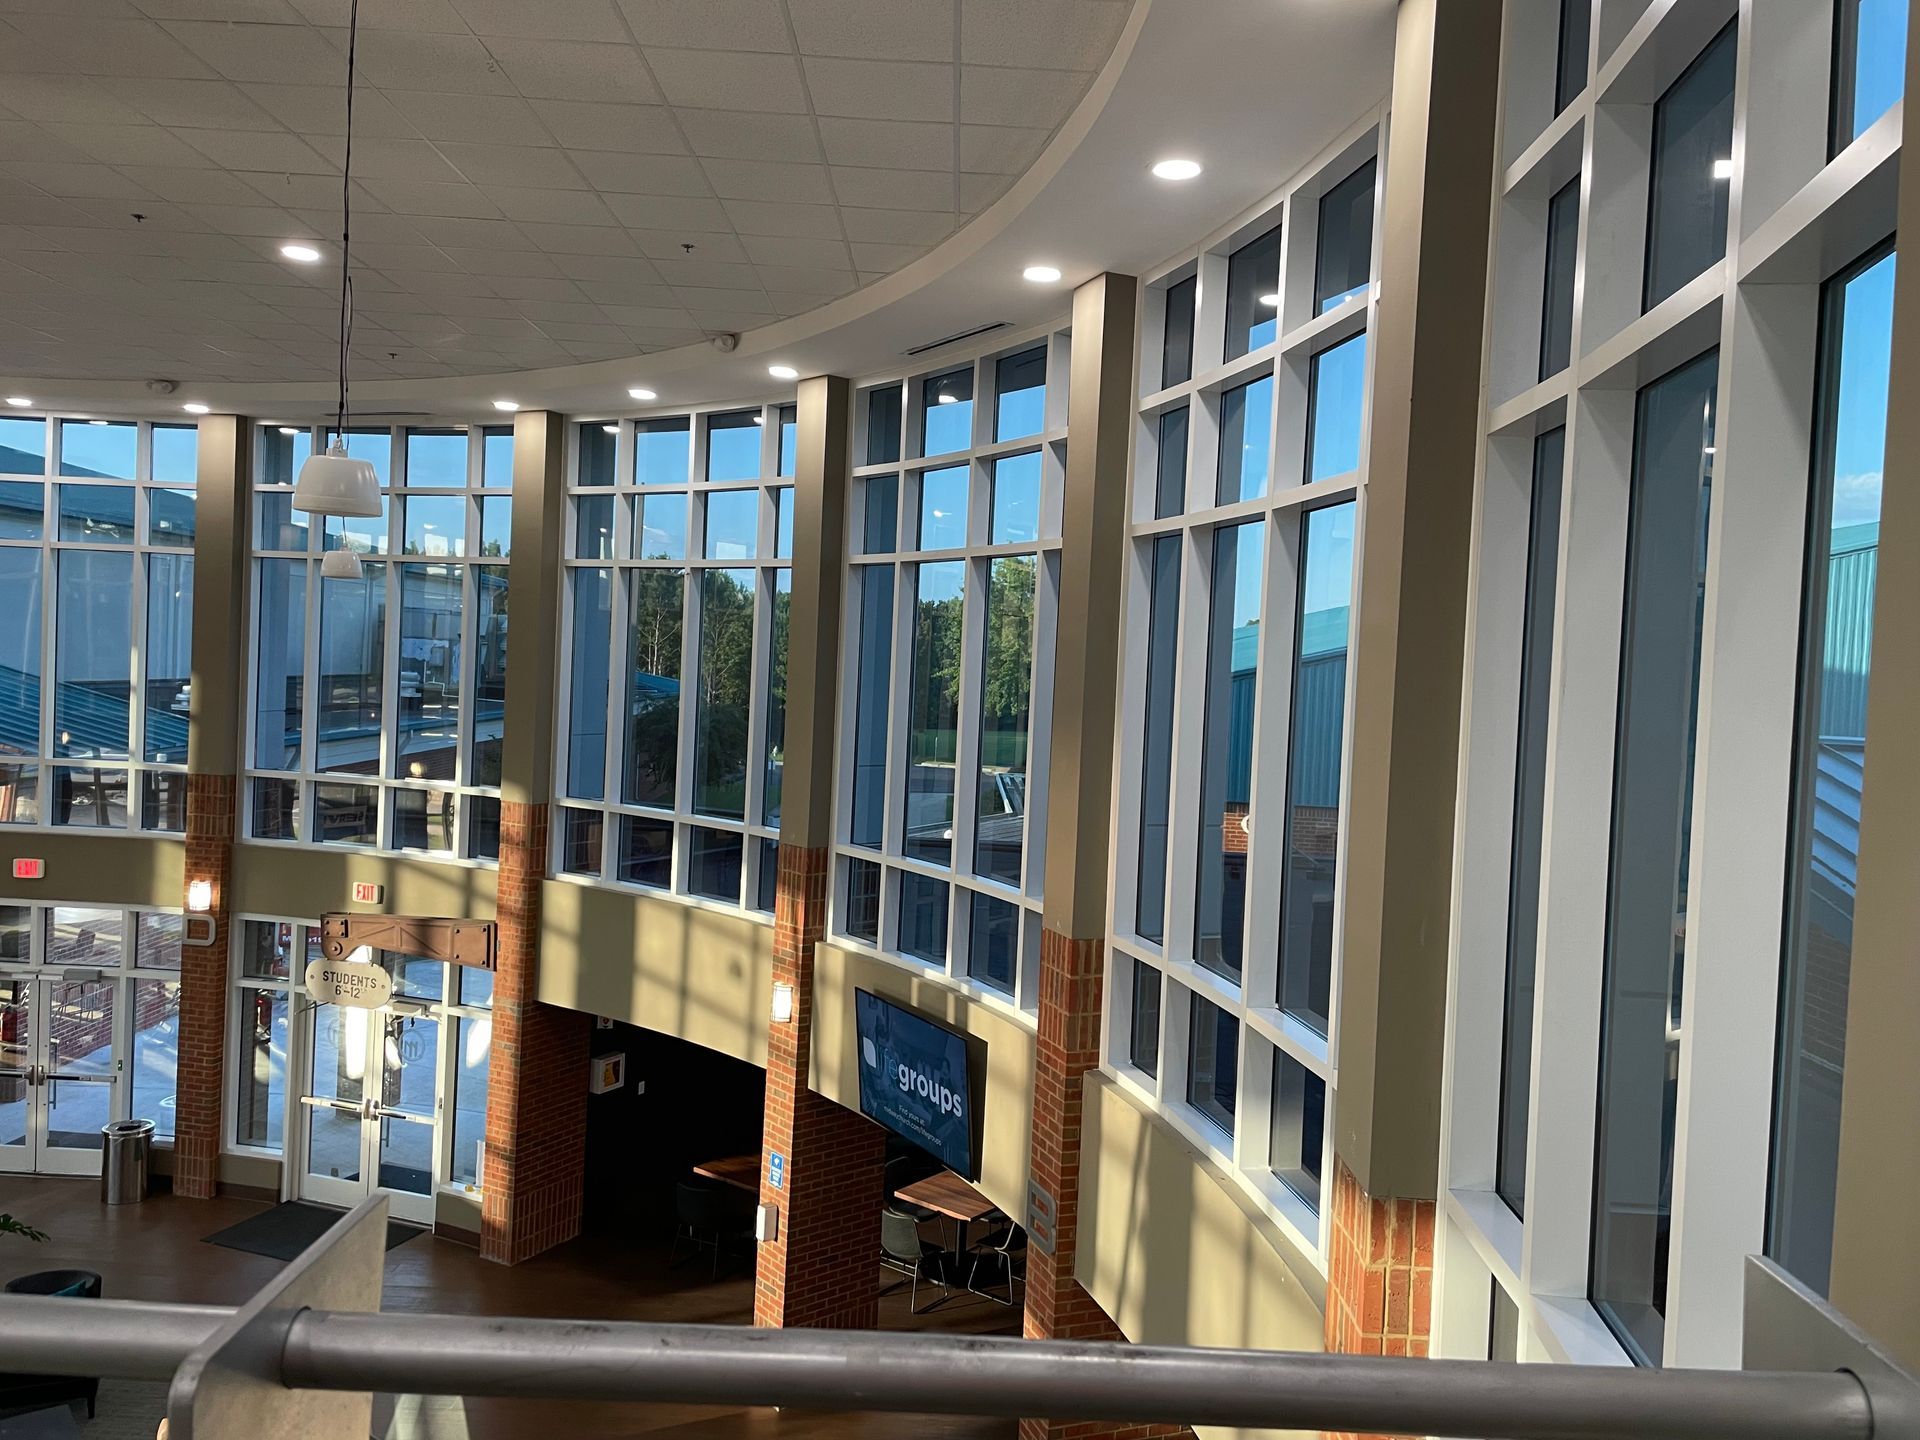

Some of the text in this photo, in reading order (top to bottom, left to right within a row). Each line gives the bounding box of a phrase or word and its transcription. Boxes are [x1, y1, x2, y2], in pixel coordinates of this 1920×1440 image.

[16, 860, 39, 877] EXIT
[356, 883, 375, 901] EXIT
[322, 970, 377, 988] STUDENTS
